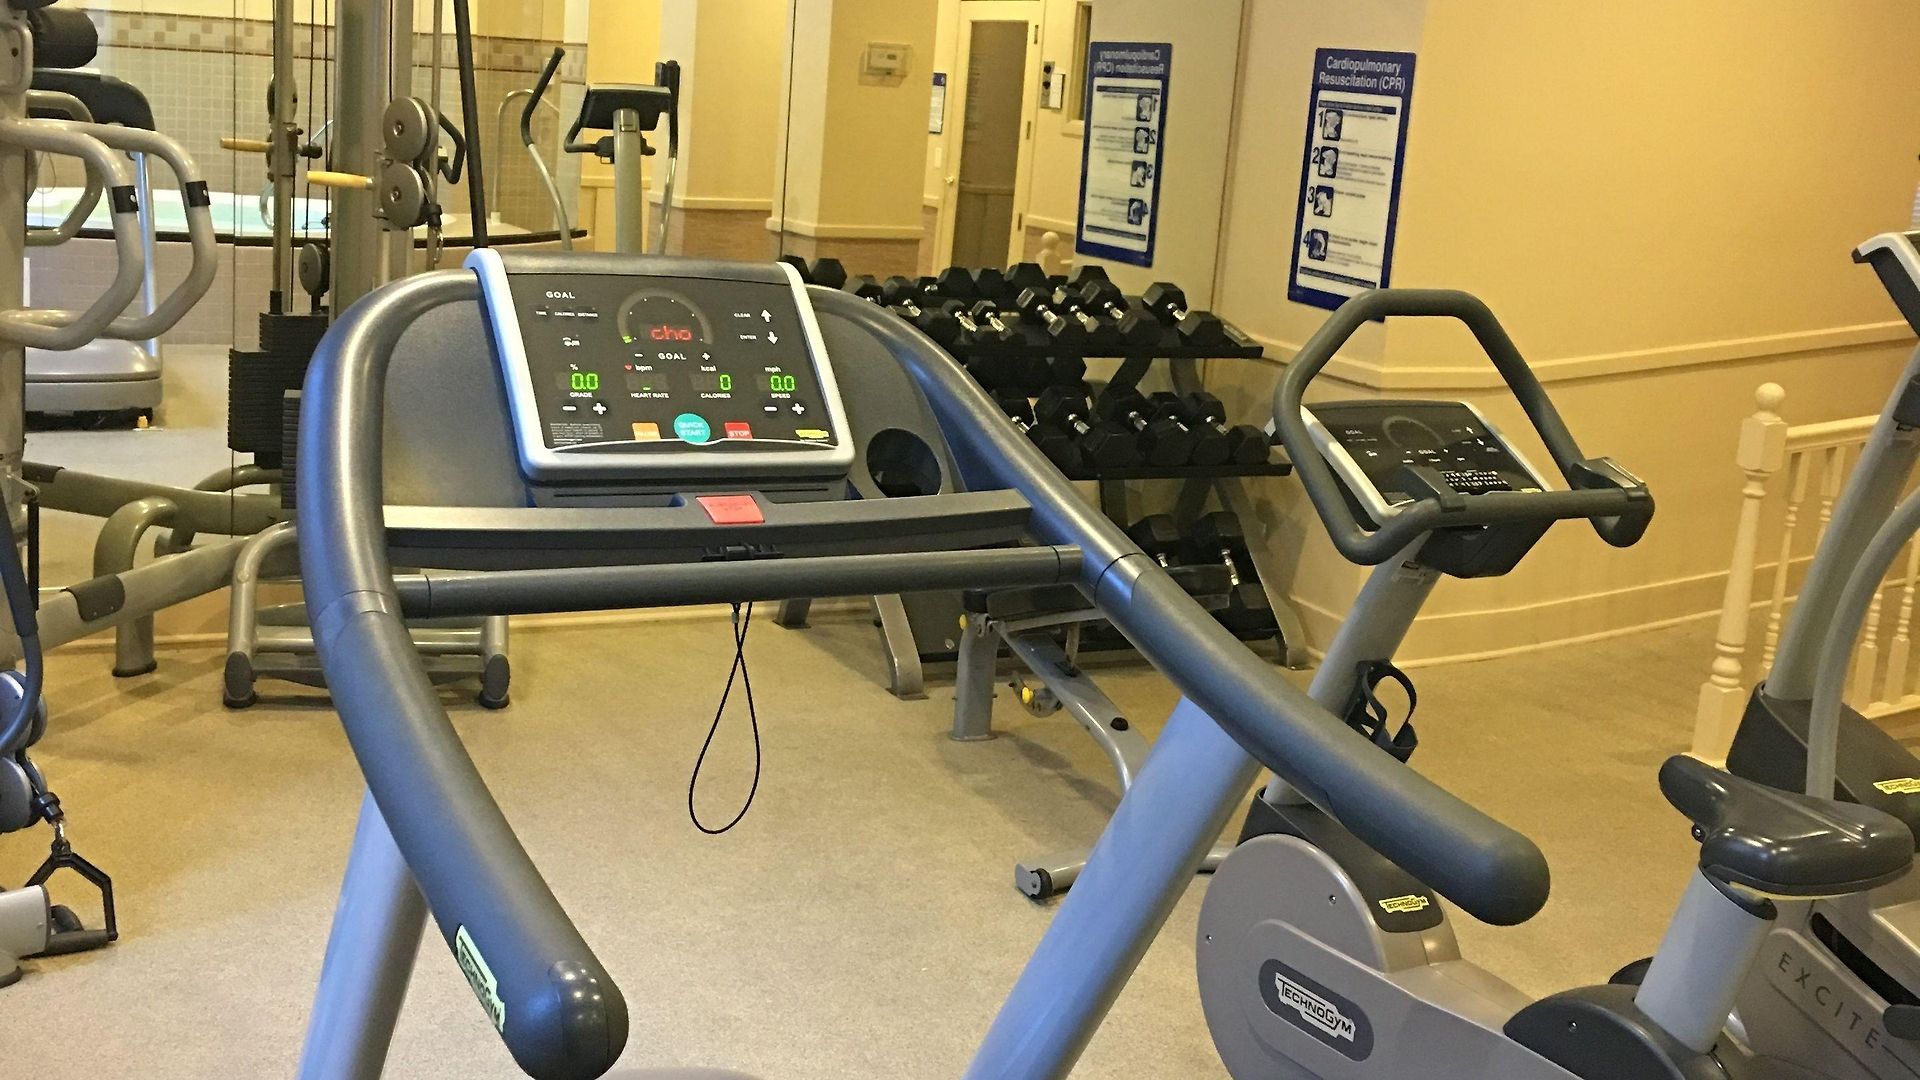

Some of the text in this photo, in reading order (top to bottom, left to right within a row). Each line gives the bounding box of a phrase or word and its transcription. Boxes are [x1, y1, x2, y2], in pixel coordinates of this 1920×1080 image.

[1326, 55, 1402, 77] Cardiopulmonary
[1319, 71, 1406, 94] Resuscitation (CPR)
[1318, 110, 1324, 128] 1
[1312, 146, 1321, 164] 2
[1307, 185, 1316, 203] 3
[1302, 230, 1311, 248] 4
[545, 290, 576, 299] GOAL
[657, 352, 687, 360] GOAL
[635, 364, 653, 373] bpm
[764, 365, 782, 373] mph
[571, 373, 599, 390] 0.0
[719, 374, 732, 391] 0
[770, 375, 796, 391] 0.0
[728, 430, 750, 438] STOP
[1277, 977, 1352, 1035] TECHNOGYM
[1778, 952, 1881, 1049] EXCITE
